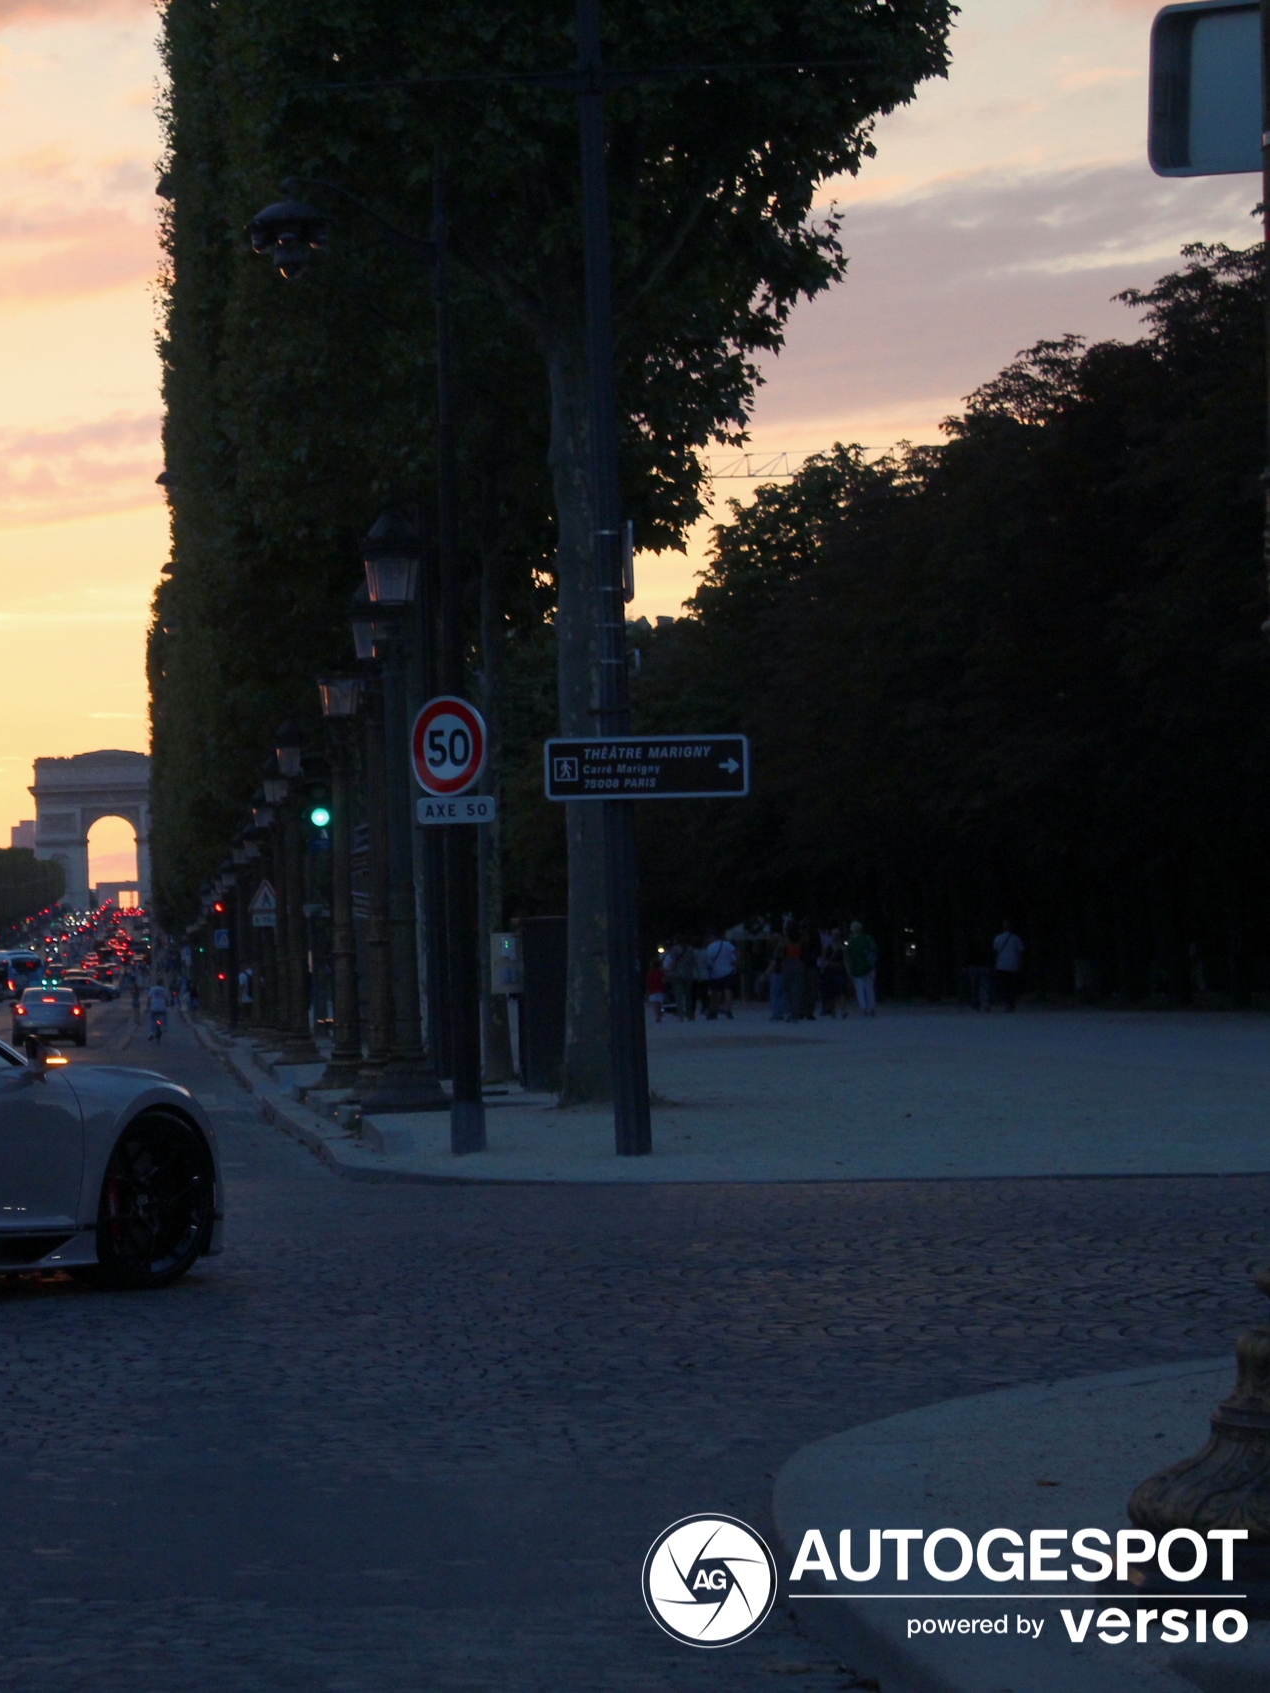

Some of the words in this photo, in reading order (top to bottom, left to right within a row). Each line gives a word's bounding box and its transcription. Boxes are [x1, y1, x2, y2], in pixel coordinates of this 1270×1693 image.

[428, 729, 470, 767] 50
[648, 745, 711, 758] MARIGNY
[616, 763, 661, 775] Marigny
[584, 778, 620, 788] 75008
[624, 777, 656, 787] PARIS
[425, 803, 456, 817] AXE
[466, 803, 487, 816] 50
